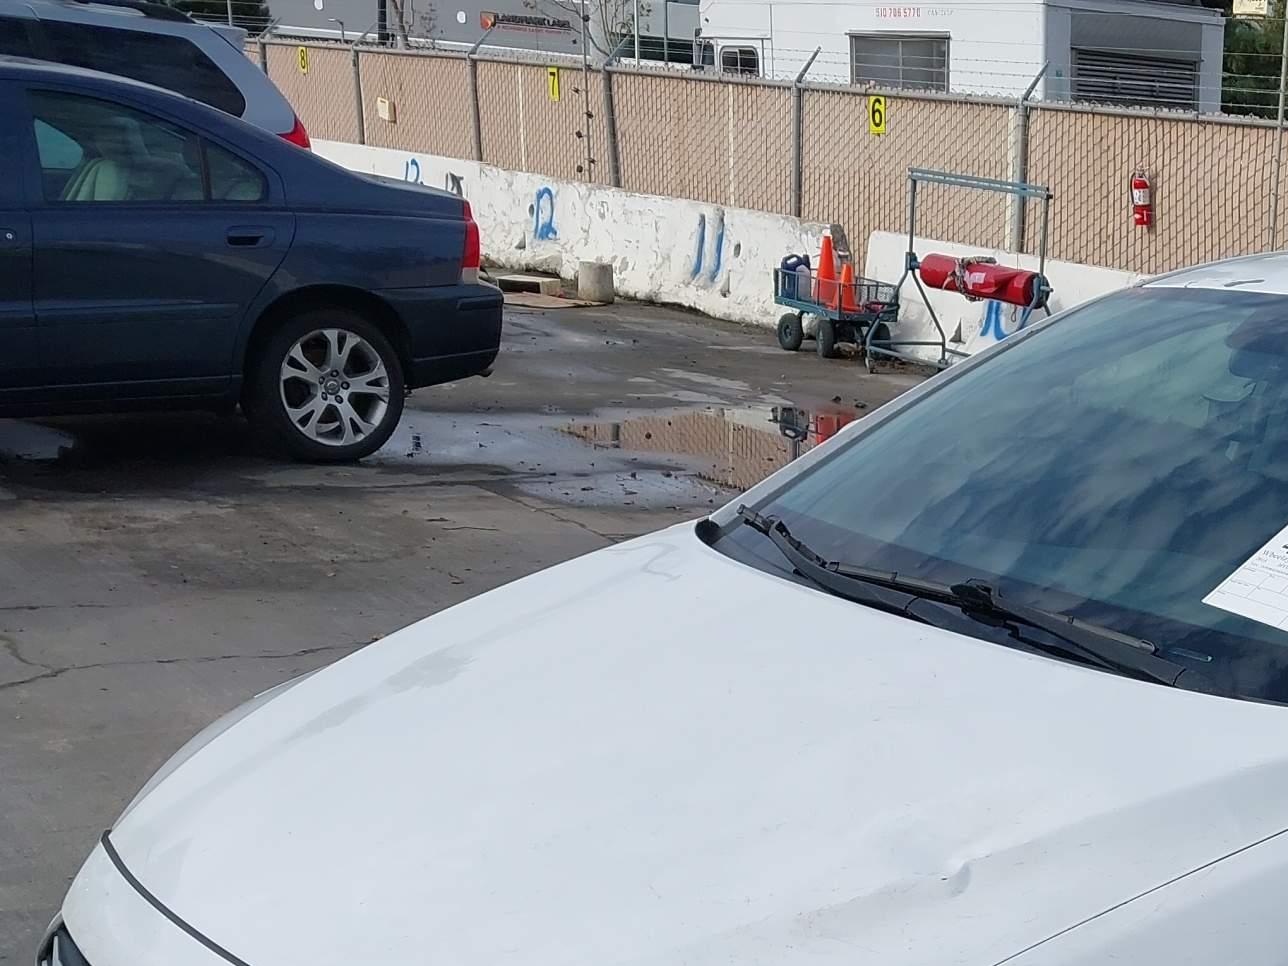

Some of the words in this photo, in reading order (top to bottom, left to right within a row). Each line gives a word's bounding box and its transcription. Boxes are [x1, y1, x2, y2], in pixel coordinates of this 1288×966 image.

[299, 48, 307, 71] 8
[549, 71, 557, 96] 7
[871, 97, 883, 128] 6
